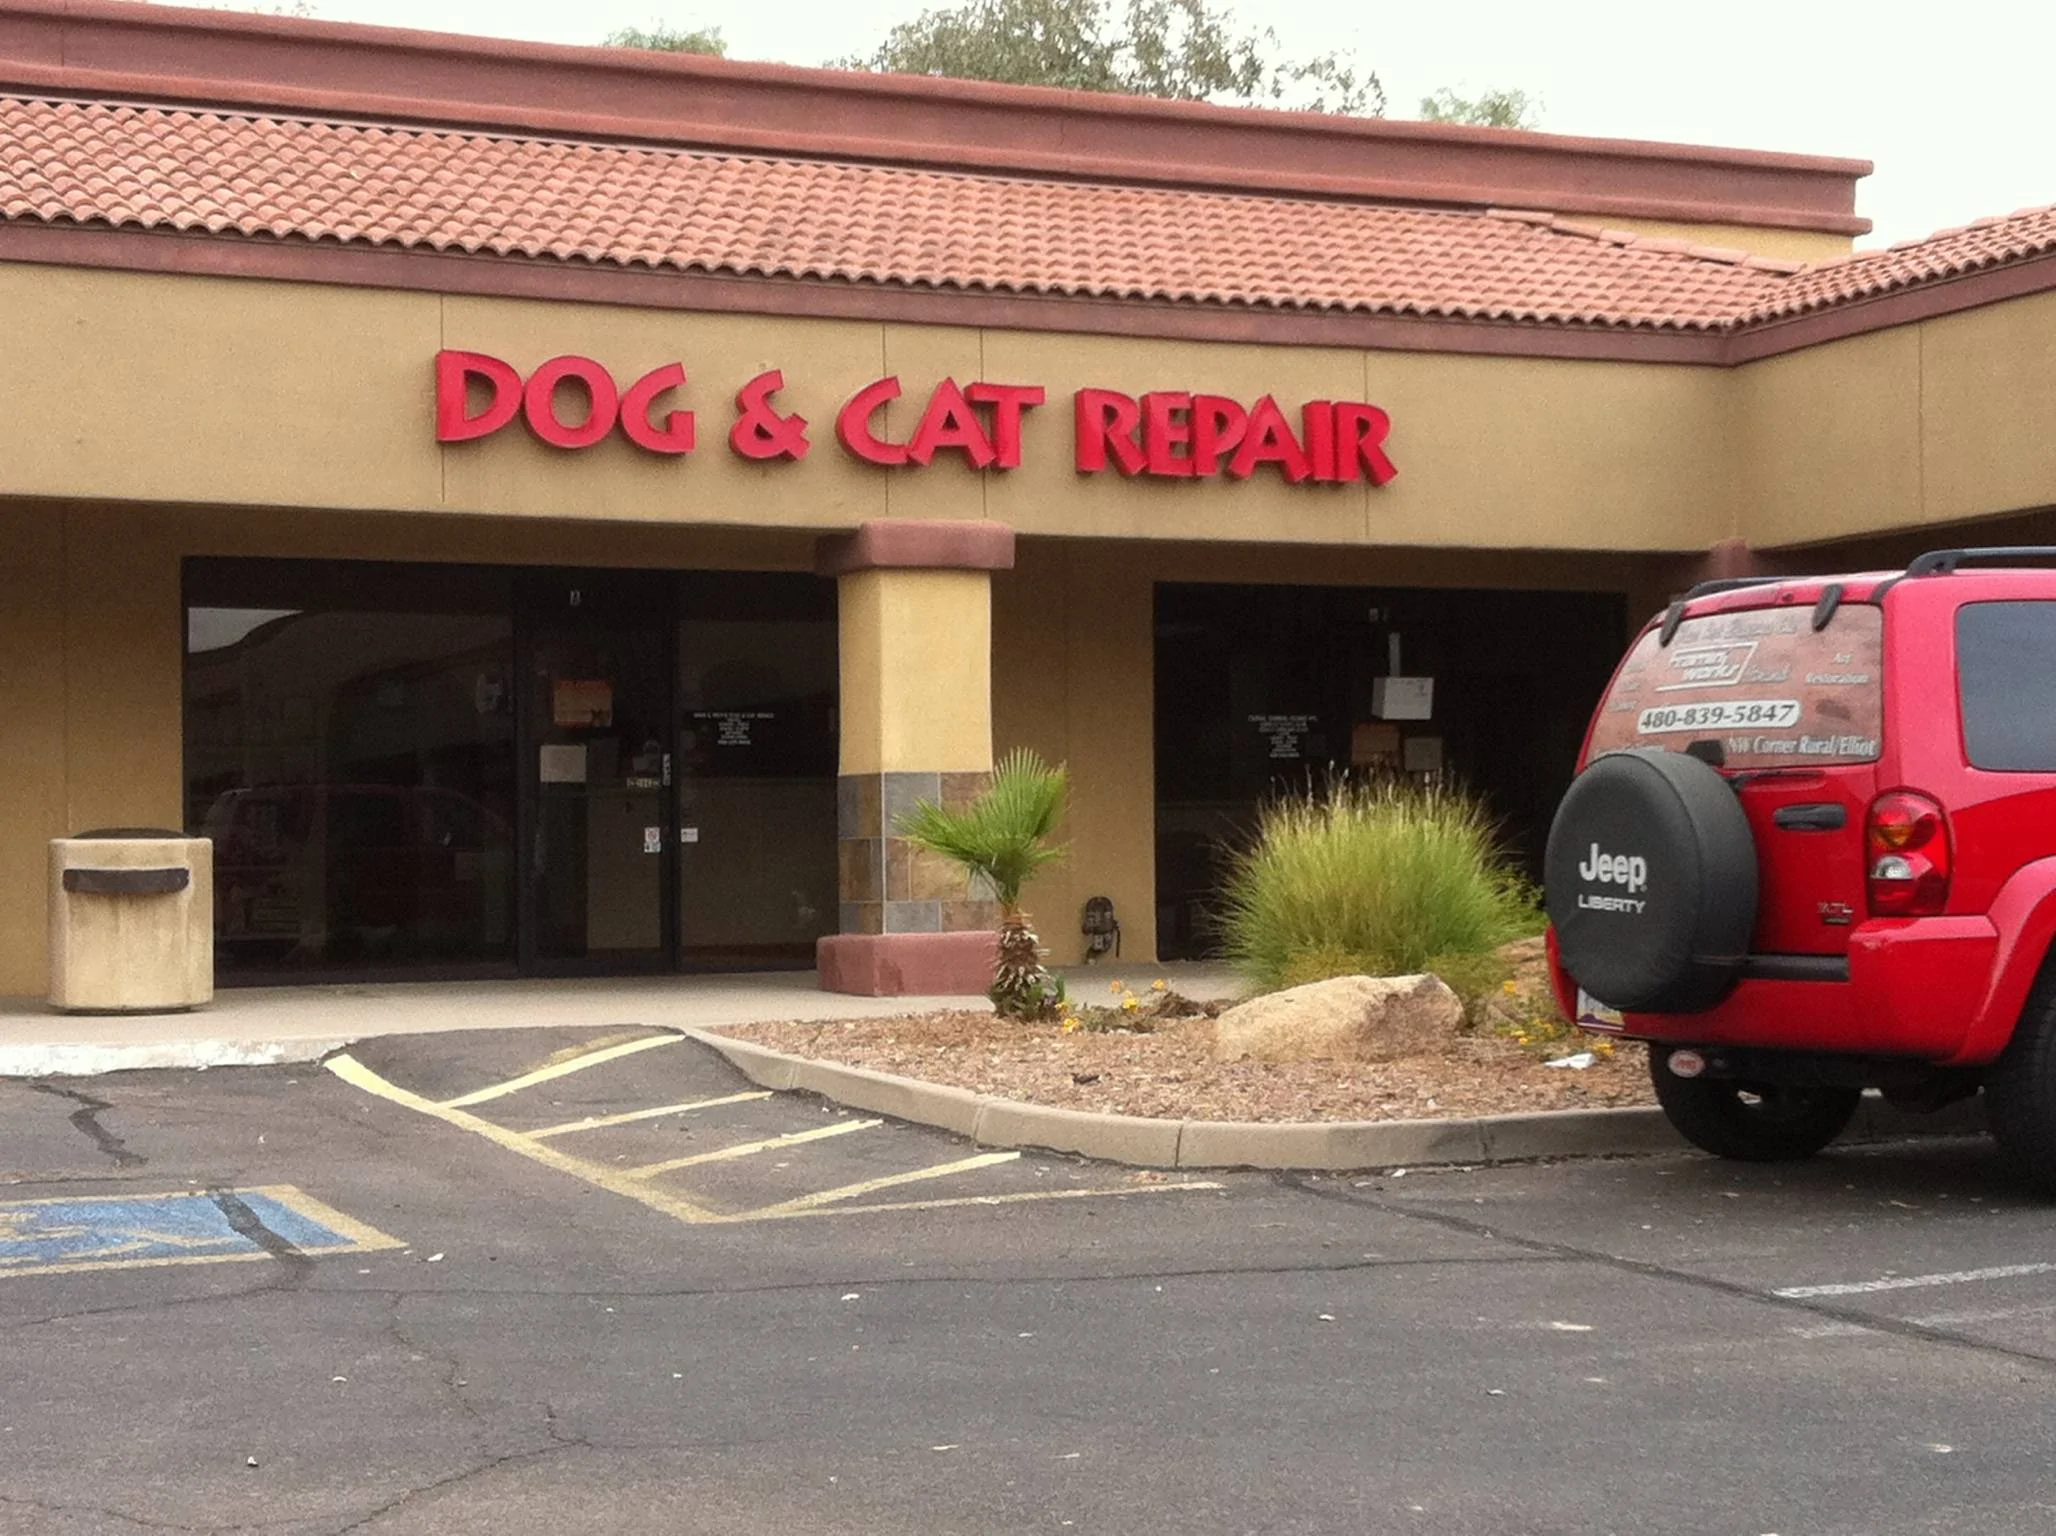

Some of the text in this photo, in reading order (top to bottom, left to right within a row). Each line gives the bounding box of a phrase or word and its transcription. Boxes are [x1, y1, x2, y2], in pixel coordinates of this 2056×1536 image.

[435, 348, 1399, 486] DOG & CAT REPAIR
[1640, 704, 1795, 729] 480-839-5847
[1753, 736, 1797, 756] Corner
[1579, 842, 1648, 893] Jeep
[1577, 893, 1646, 915] LIBERTY
